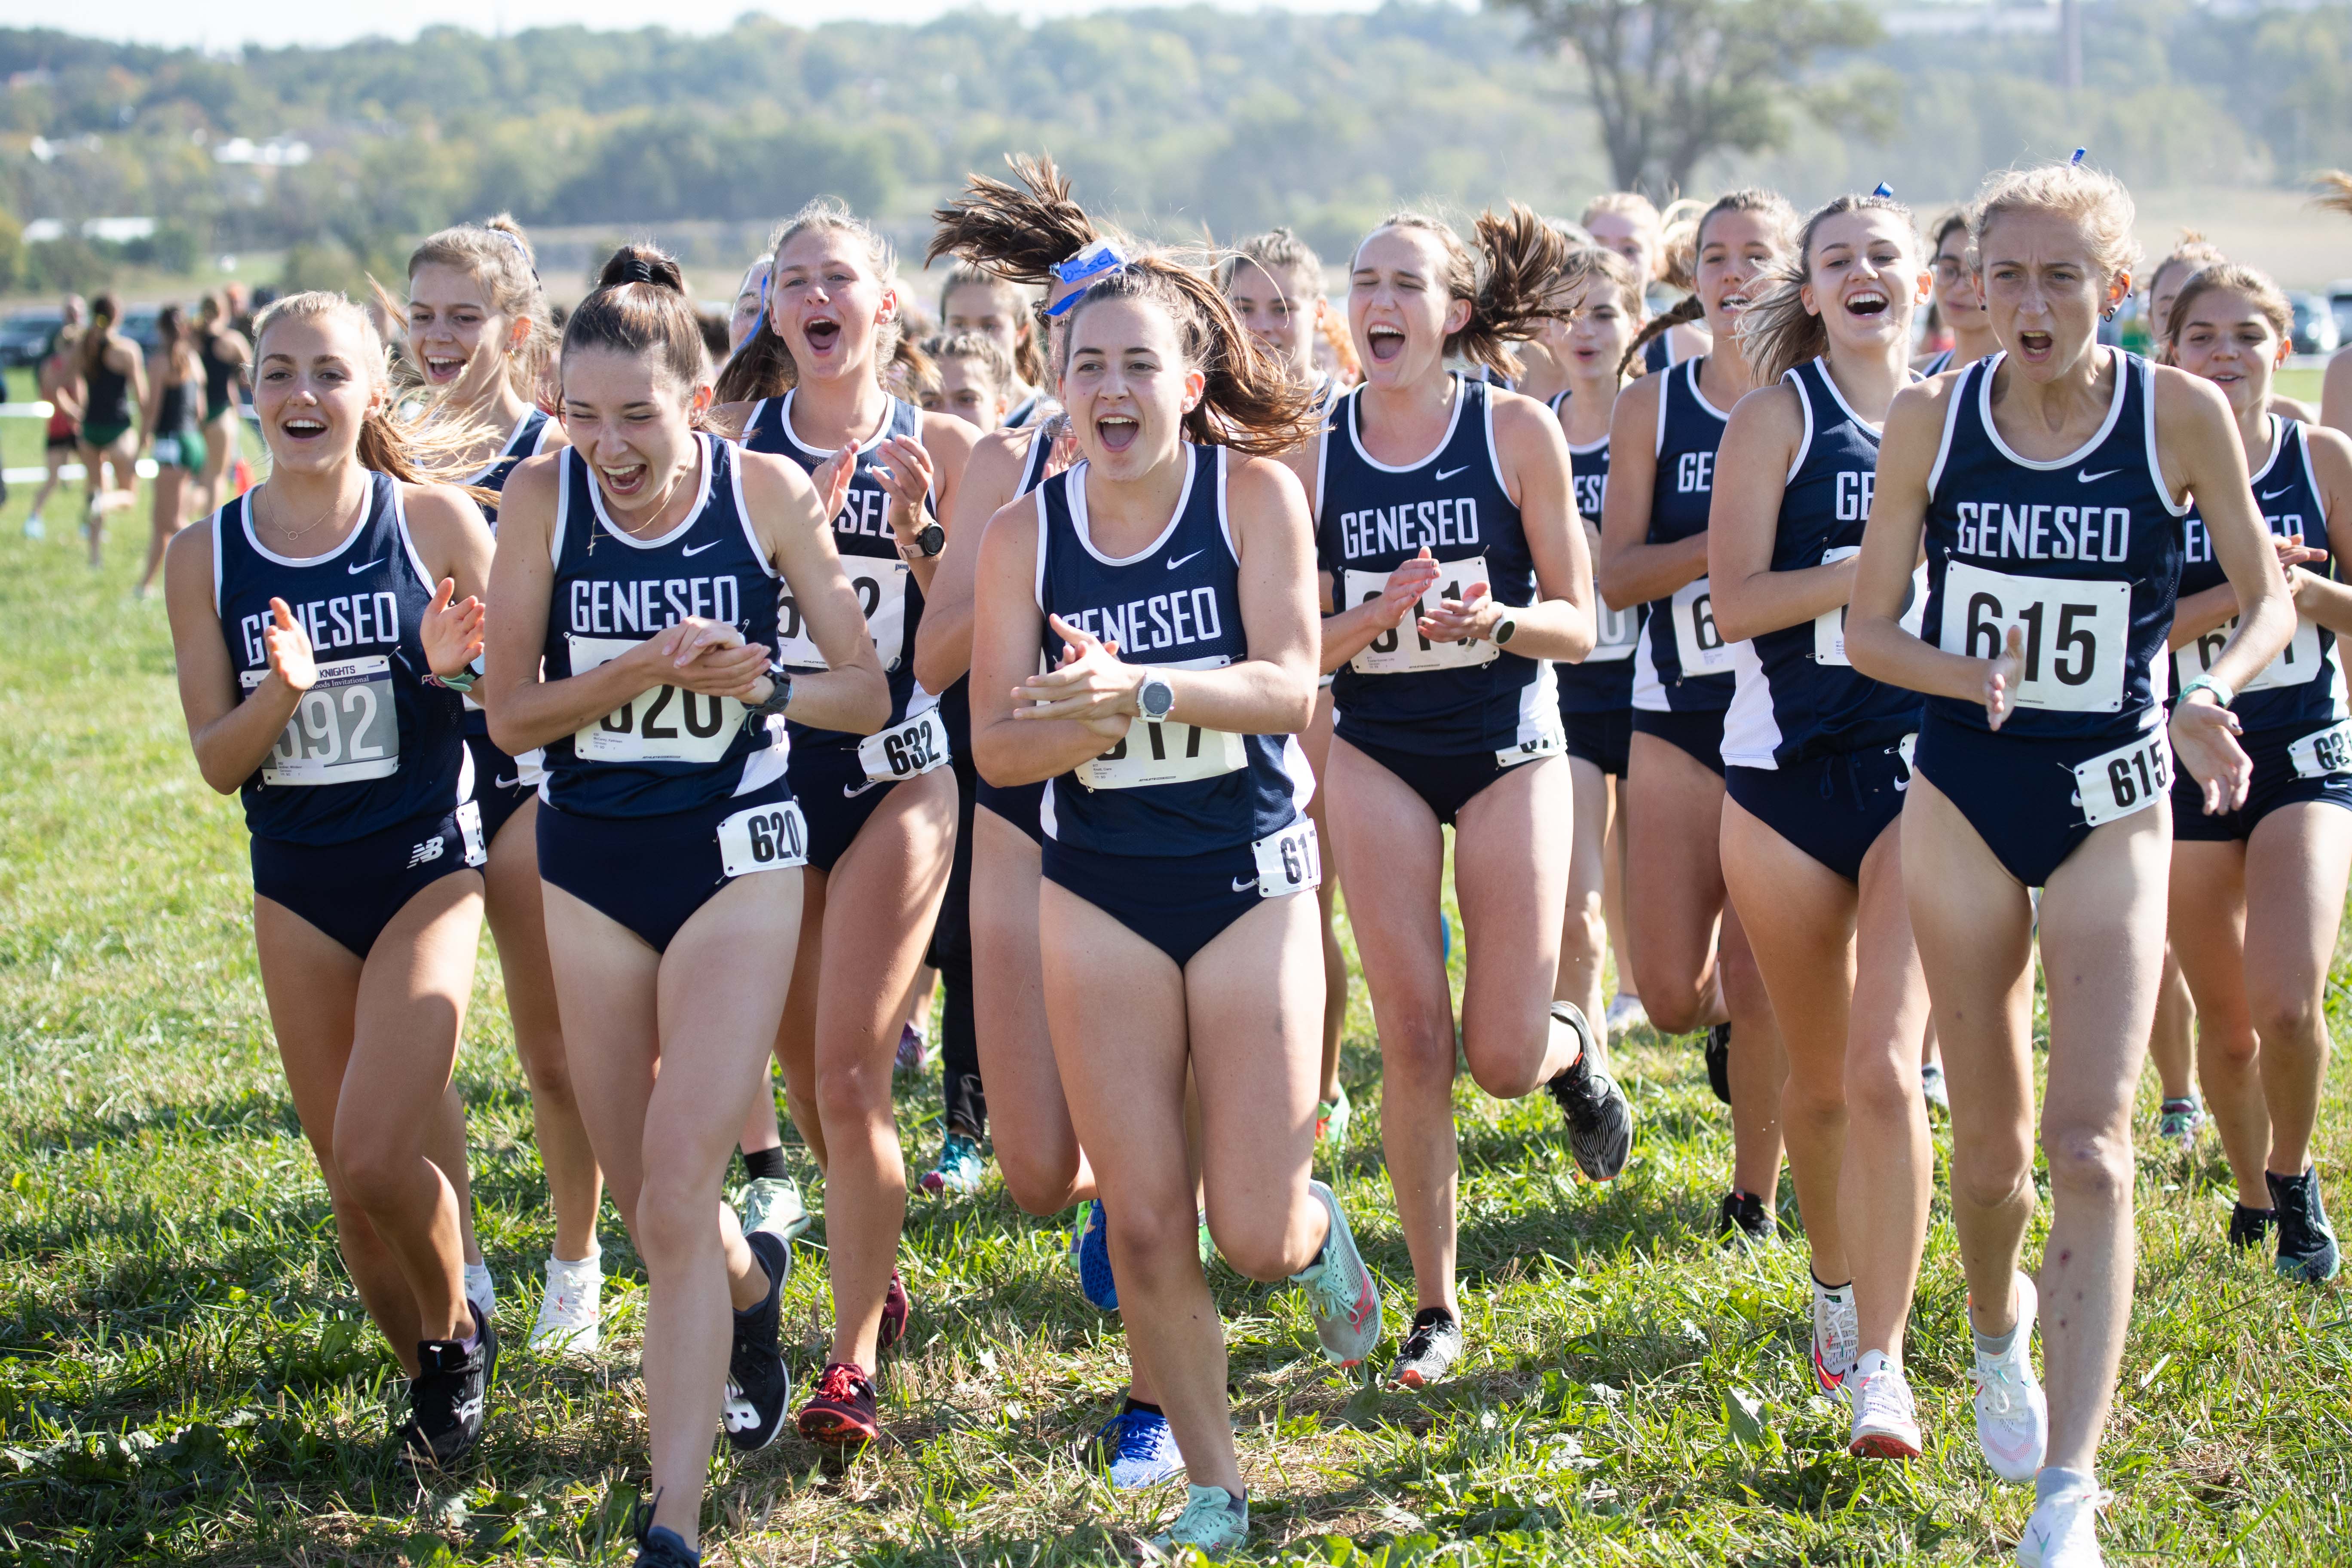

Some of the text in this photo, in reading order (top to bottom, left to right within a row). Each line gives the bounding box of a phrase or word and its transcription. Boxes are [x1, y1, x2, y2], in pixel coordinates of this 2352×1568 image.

[1340, 497, 1479, 559] GENESEO
[1957, 502, 2130, 562] GENESEO
[570, 575, 738, 633] GENESEO
[1966, 591, 2098, 686] 615
[319, 665, 356, 679] KNIGHTS
[332, 675, 370, 687] Invitational
[883, 720, 940, 775] 632
[2107, 739, 2167, 808] 615
[747, 809, 802, 863] 620
